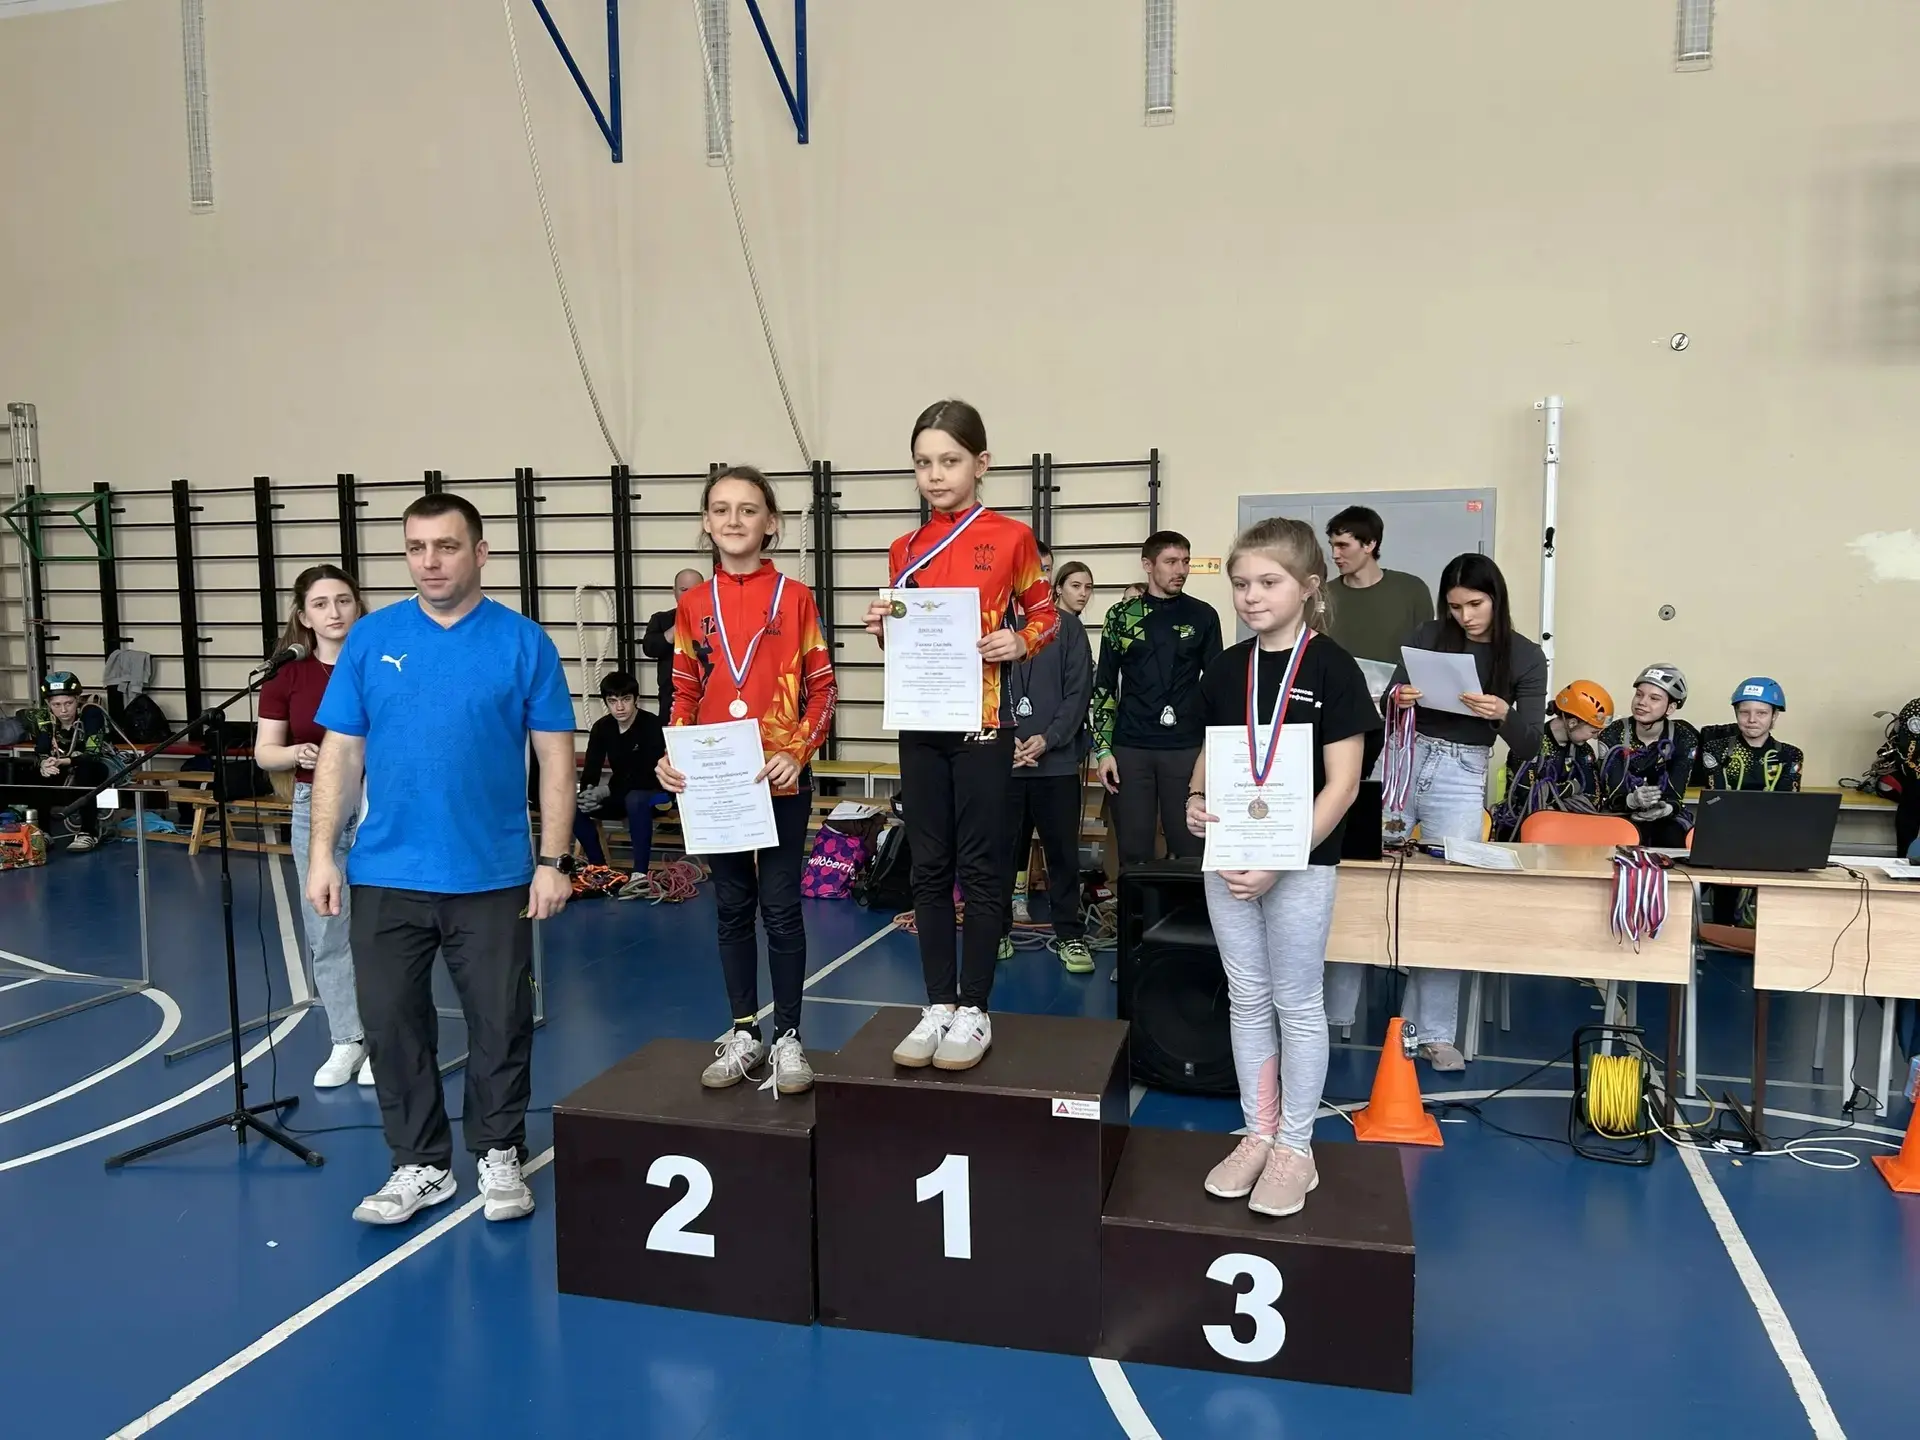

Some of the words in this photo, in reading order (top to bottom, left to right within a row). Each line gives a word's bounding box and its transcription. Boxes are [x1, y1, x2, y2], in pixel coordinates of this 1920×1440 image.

[646, 1155, 715, 1258] 2
[916, 1154, 972, 1259] 1
[1202, 1253, 1286, 1363] 3
